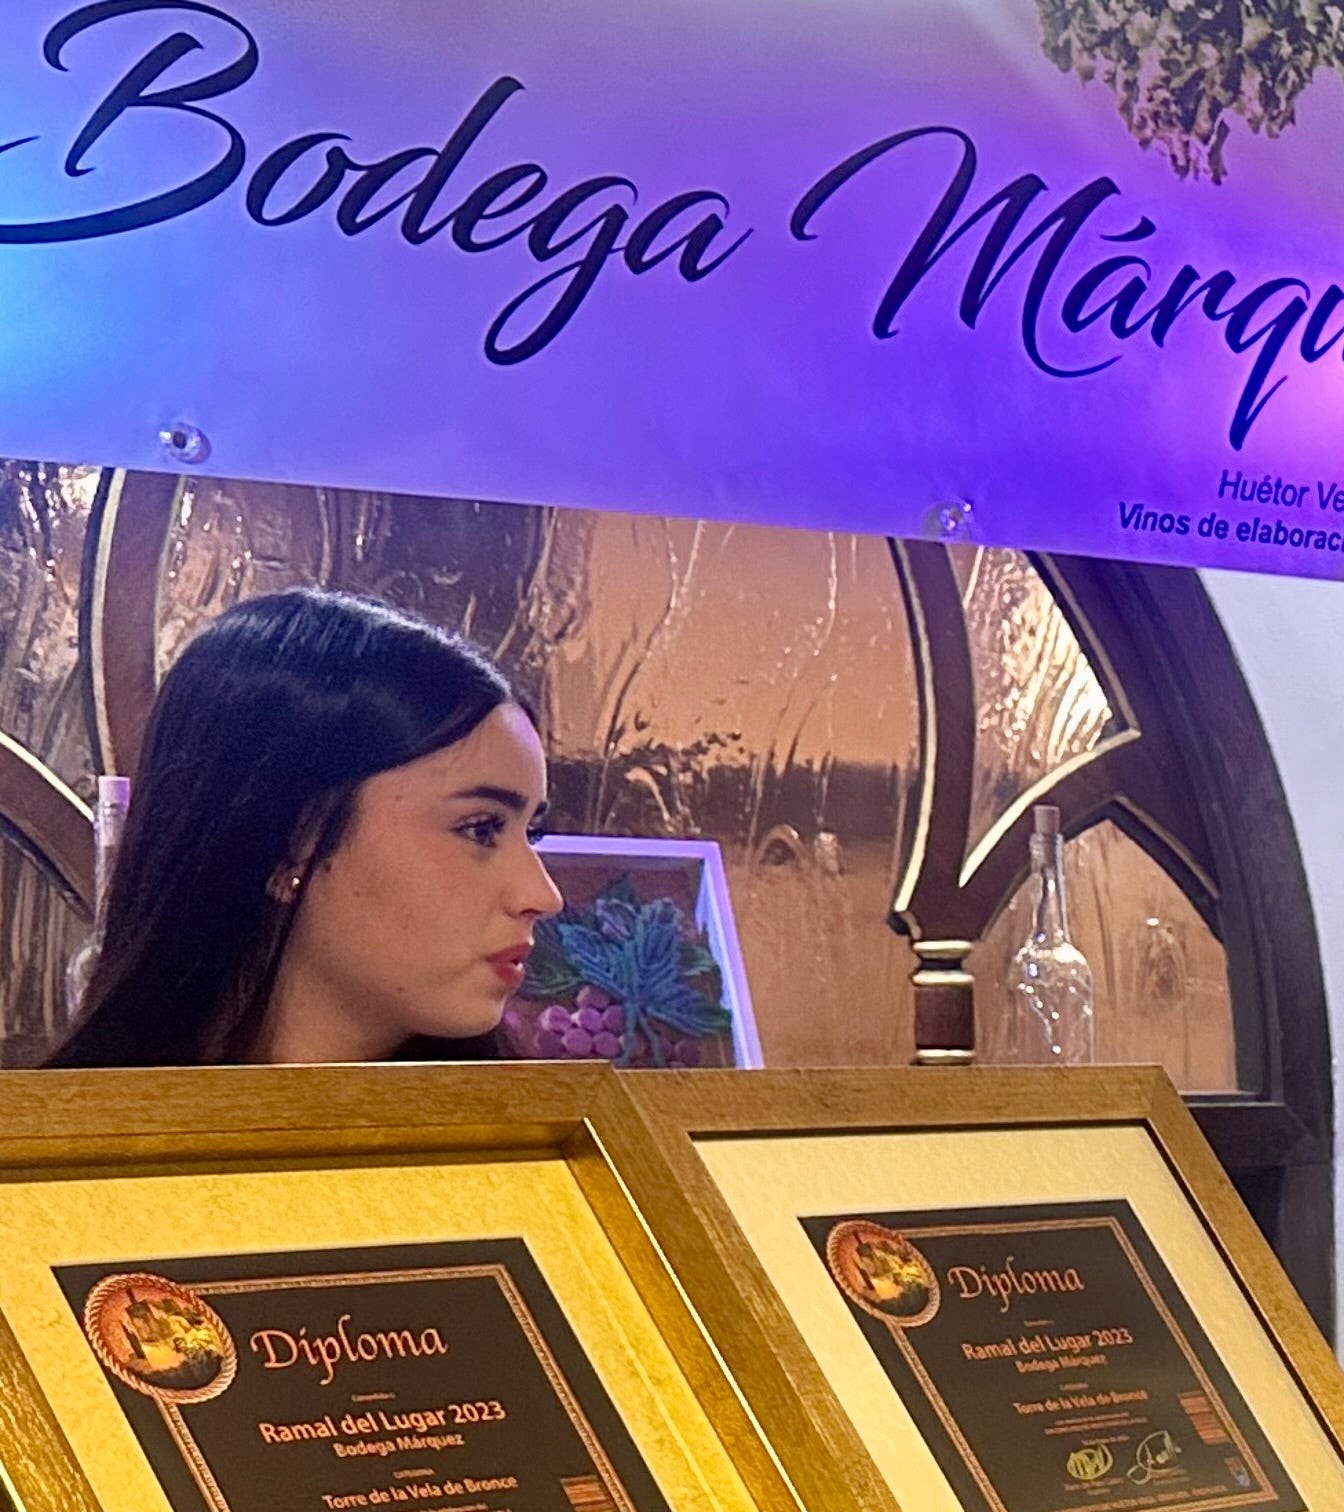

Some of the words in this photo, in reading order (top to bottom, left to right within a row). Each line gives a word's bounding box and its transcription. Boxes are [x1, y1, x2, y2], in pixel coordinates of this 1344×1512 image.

[0, 0, 754, 366] Bodega
[1217, 468, 1310, 506] Huétor
[1118, 501, 1191, 535] Vinos
[1198, 512, 1228, 540] de
[946, 1255, 1086, 1313] Diploma
[249, 1313, 449, 1386] Diploma
[960, 1338, 1018, 1361] Ramal
[1019, 1335, 1046, 1355] del
[1044, 1332, 1093, 1354] Lugar
[1092, 1327, 1134, 1347] 2023
[258, 1416, 338, 1444] Ramal
[341, 1411, 377, 1435] del
[378, 1407, 447, 1433] Lugar
[447, 1400, 506, 1424] 2023
[332, 1438, 396, 1458] Bodega
[396, 1432, 465, 1451] Márquez
[321, 1493, 369, 1510] Torre
[369, 1488, 391, 1504] de
[391, 1487, 409, 1501] la
[406, 1482, 443, 1499] Vela
[443, 1479, 465, 1495] de
[464, 1475, 519, 1493] Bronce
